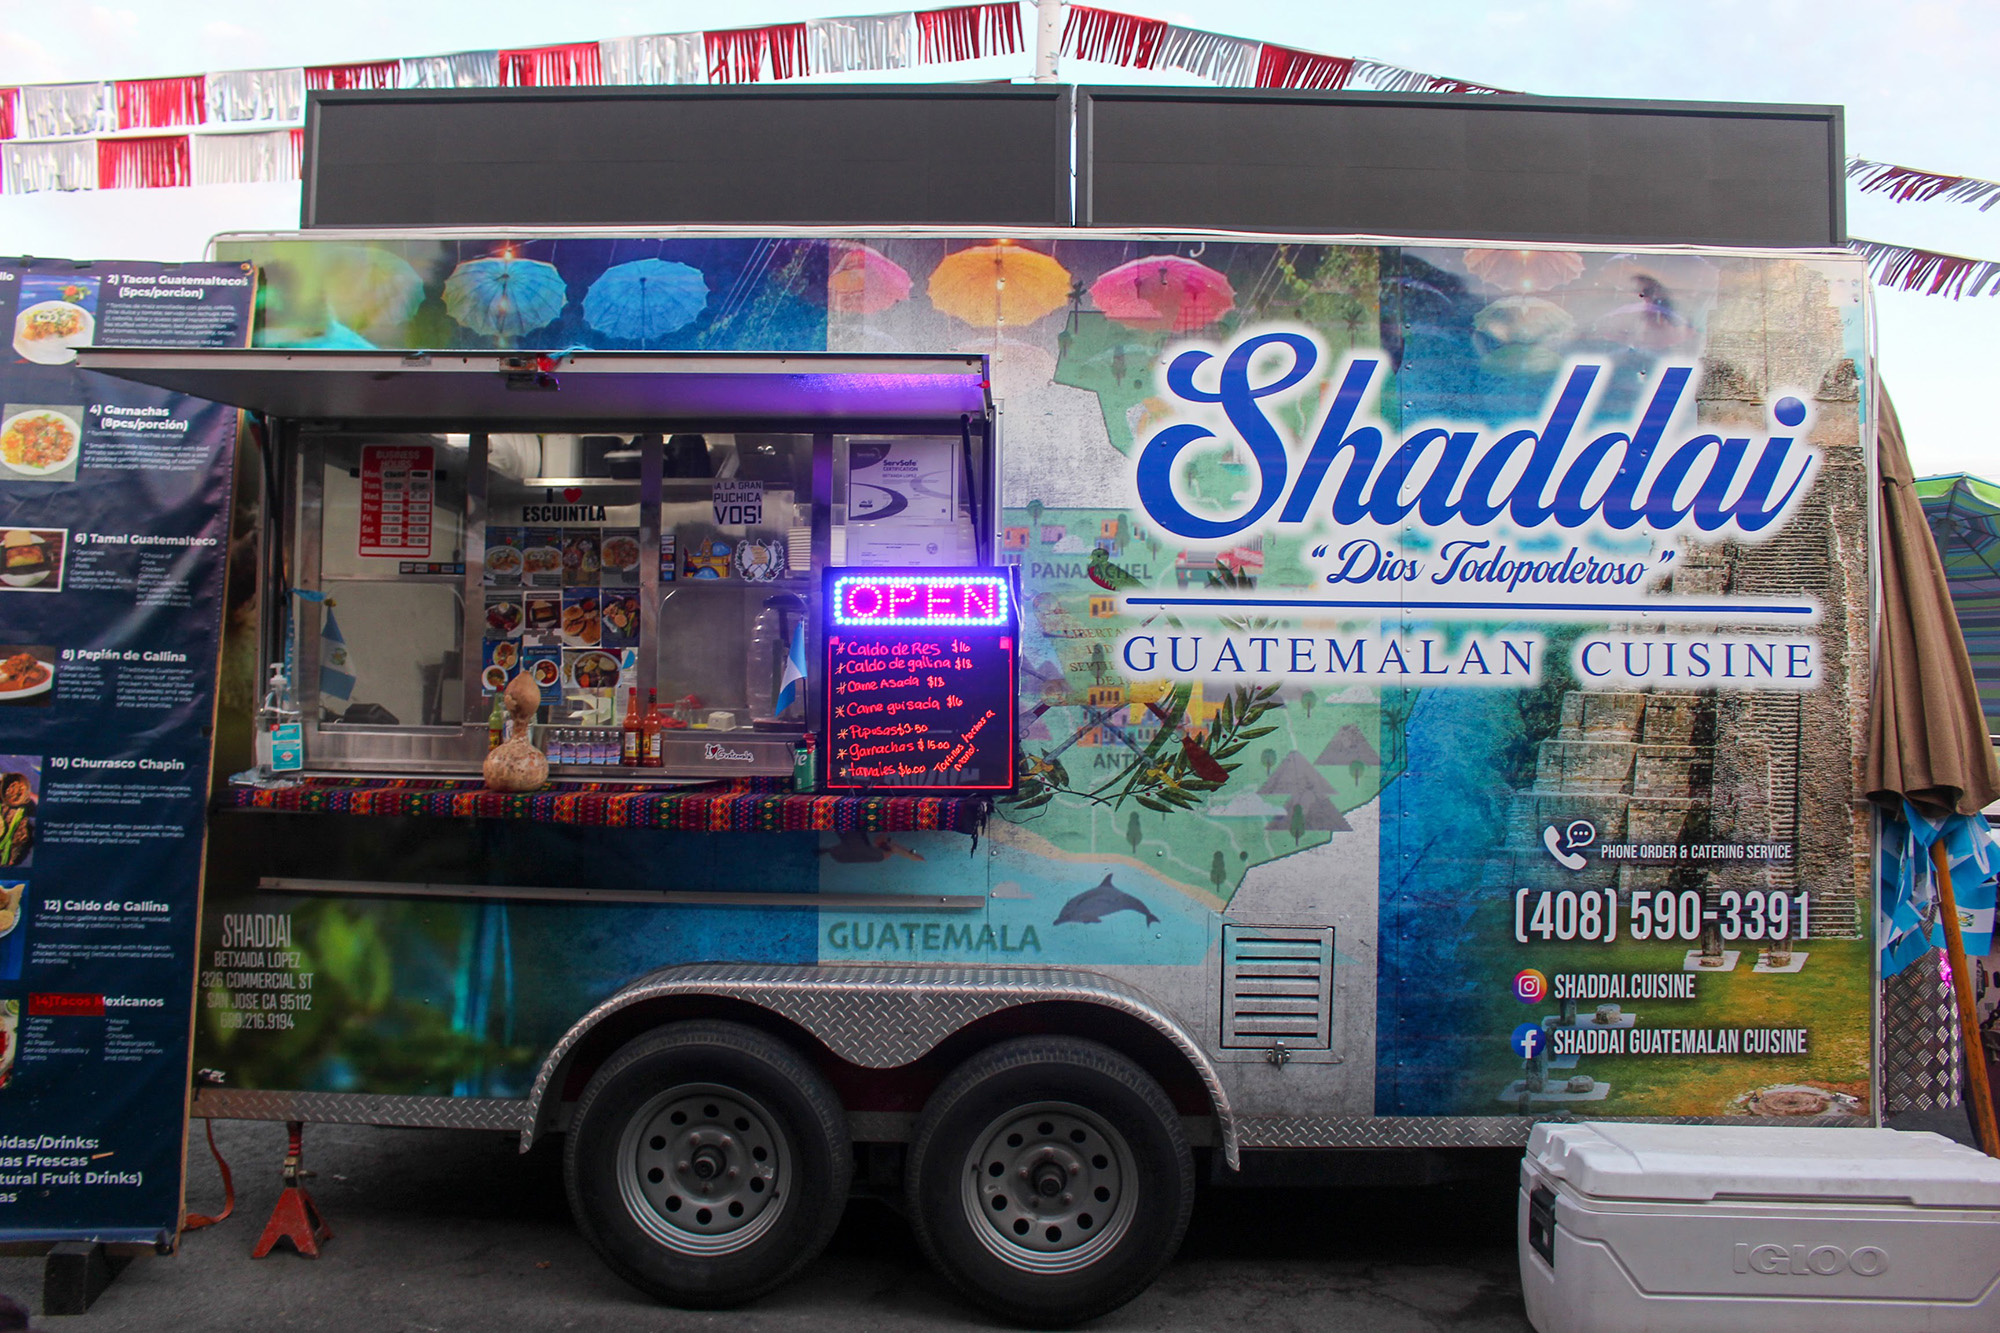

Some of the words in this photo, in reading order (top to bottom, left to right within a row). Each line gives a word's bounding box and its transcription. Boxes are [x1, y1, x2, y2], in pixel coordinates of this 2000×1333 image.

[107, 275, 119, 285] 2)
[122, 275, 156, 285] Tacos
[158, 275, 248, 286] Guatemaltecos
[119, 286, 204, 299] (5pcs/porcion)
[89, 404, 102, 416] 4)
[104, 405, 170, 416] Garnachas
[101, 417, 188, 432] (8pcs/porción)
[1137, 332, 1813, 539] Shaddai
[724, 482, 736, 490] LA
[739, 482, 762, 490] GRAN
[547, 488, 553, 503] I
[714, 492, 761, 503] PUCHICA
[523, 505, 607, 522] ESCUINTLA
[714, 505, 762, 524] VOS!
[74, 533, 87, 545] 6)
[90, 534, 128, 545] Tamal
[130, 535, 217, 546] Guatemalteco
[1031, 562, 1153, 580] PANAJACHEL
[848, 584, 994, 618] OPEN
[1064, 628, 1128, 639] LIBERTA
[61, 649, 76, 661] 8)
[77, 648, 120, 662] Pepián
[123, 650, 140, 661] de
[142, 651, 187, 662] Gallina
[847, 641, 889, 656] Caldo
[891, 642, 909, 656] de
[911, 642, 941, 656] Res
[952, 639, 972, 654] $16
[846, 658, 886, 674] Caldo
[889, 657, 906, 669] de
[907, 655, 951, 672] gallina
[955, 657, 973, 670] $18
[1122, 635, 1536, 677] GUATEMALAN
[1581, 641, 1813, 680] CUISINE
[880, 676, 920, 688] Asada
[927, 675, 946, 688] $18
[846, 702, 884, 717] Carne
[887, 696, 941, 715] guisada
[946, 694, 964, 708] $16
[51, 757, 69, 769] 10)
[71, 758, 136, 769] Churrasco
[1602, 844, 1638, 859] PHONE
[1641, 844, 1678, 859] ORDER
[1680, 845, 1687, 859] &
[1691, 845, 1744, 860] CATERING
[1747, 845, 1792, 860] SERVICE
[44, 900, 62, 913] 12)
[64, 900, 101, 911] Caldo
[104, 901, 120, 912] de
[123, 901, 169, 912] Gallina
[1515, 887, 1617, 943] (408)
[1630, 890, 1810, 941] 590-3391
[222, 914, 292, 948] SHADDAI
[827, 921, 1043, 953] GUATEMALA
[214, 951, 265, 968] BETXAIDA
[268, 952, 301, 968] LOPEZ
[202, 971, 224, 988] 326
[226, 972, 296, 989] COMMERCIAL
[299, 973, 314, 989] ST
[1554, 973, 1697, 1000] SHADDAI.CUISINE
[95, 995, 165, 1007] Mexicanos
[207, 991, 228, 1008] SAN
[232, 993, 259, 1009] JOSE
[262, 994, 278, 1010] CA
[280, 994, 312, 1011] 95112
[1553, 1028, 1625, 1055] SHADDAI
[1630, 1028, 1741, 1055] GUATEMALAN
[1744, 1029, 1808, 1055] CUISINE
[0, 1135, 99, 1150] idas/Drinks:
[26, 1155, 89, 1167] Frescas
[41, 1171, 82, 1185] Fruit
[85, 1171, 143, 1187] Drinks)
